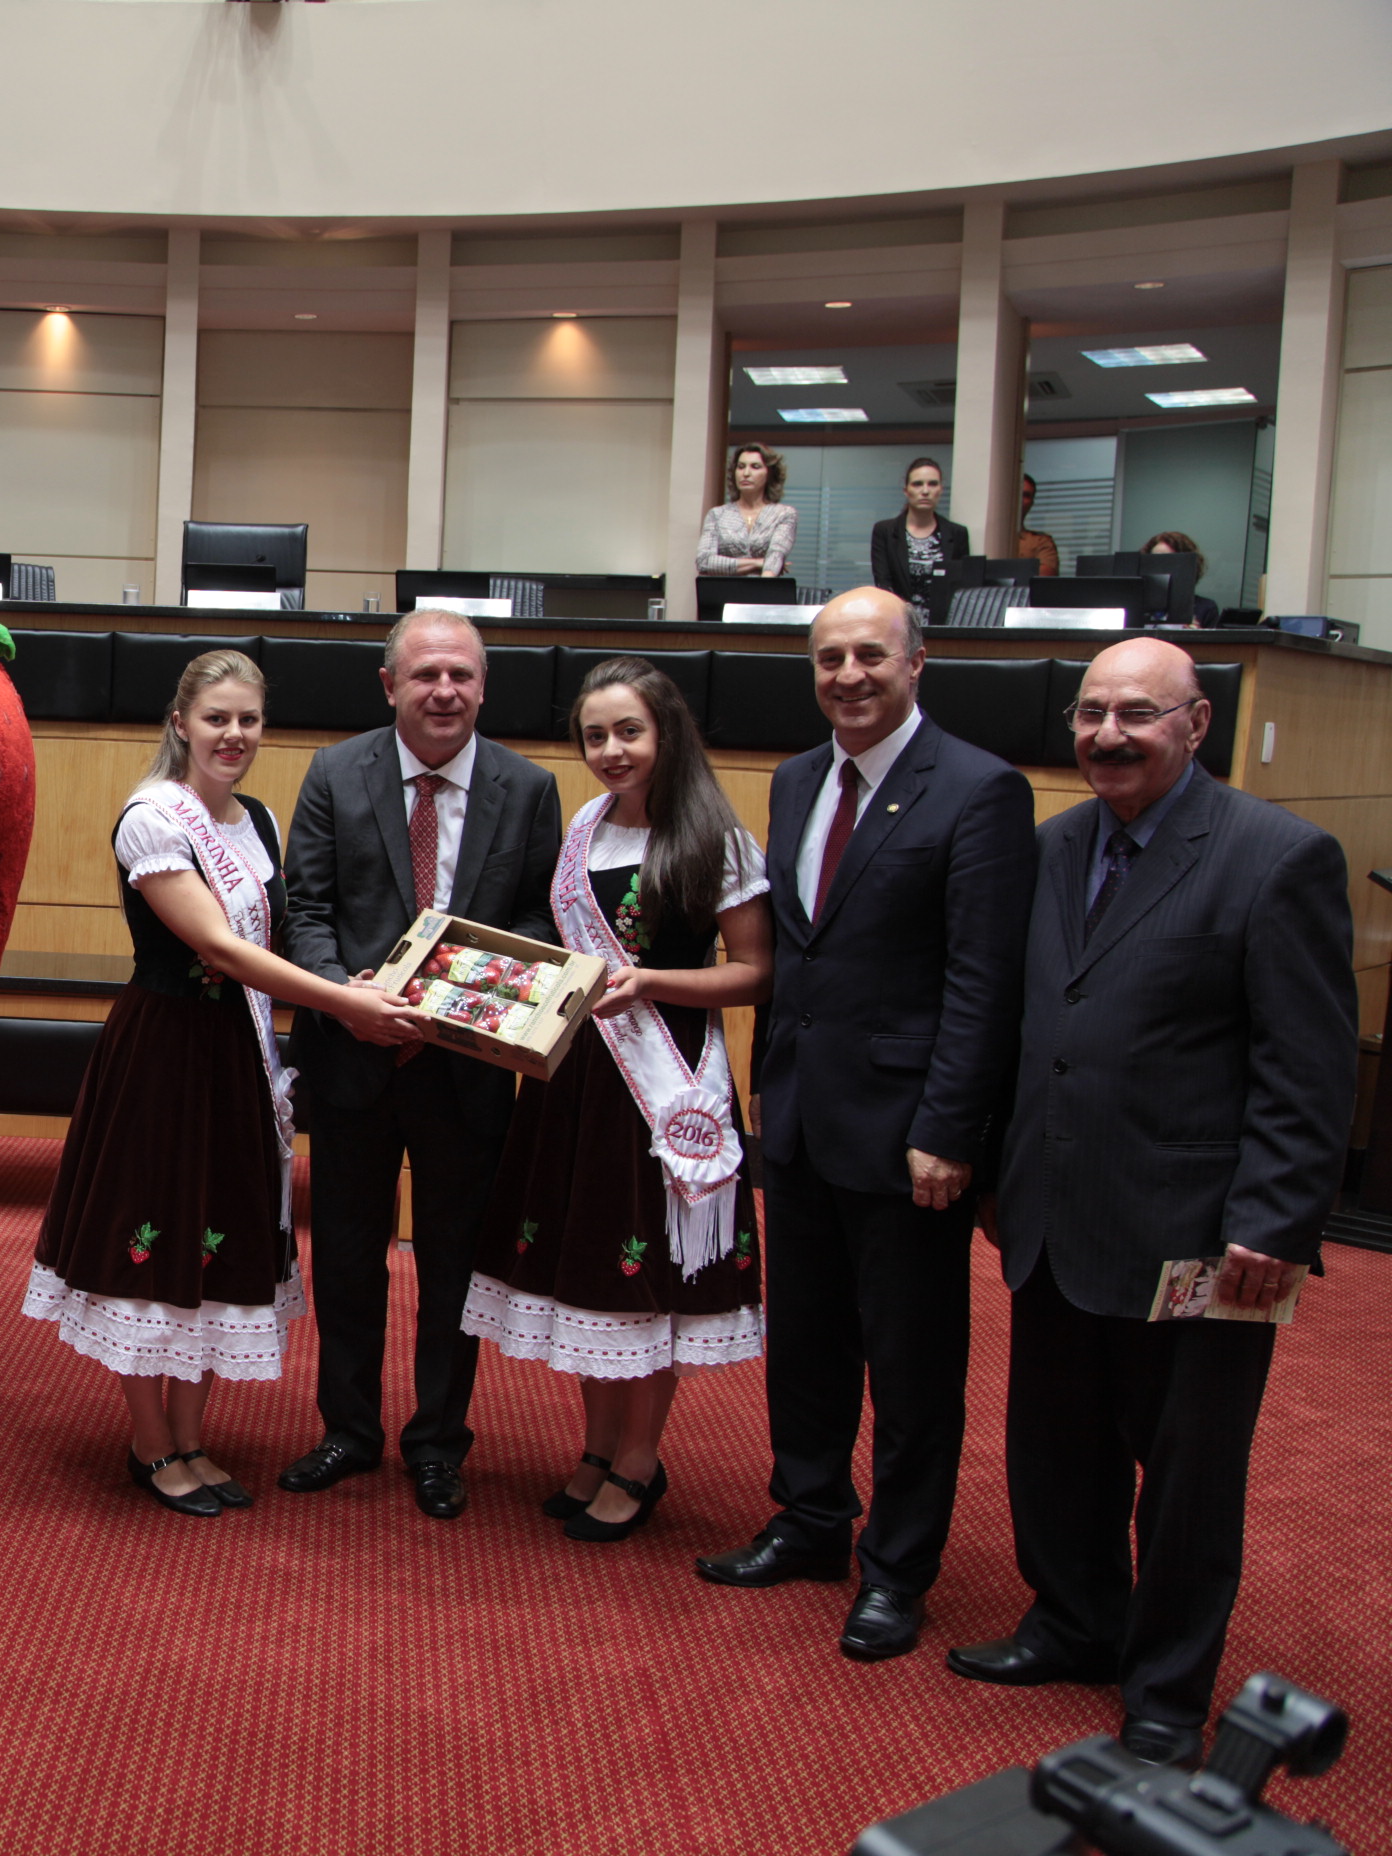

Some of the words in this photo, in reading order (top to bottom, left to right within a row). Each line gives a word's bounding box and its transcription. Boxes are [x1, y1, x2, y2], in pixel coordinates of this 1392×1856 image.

[169, 800, 245, 894] MADRINHA
[248, 903, 261, 931] XXV
[626, 1005, 642, 1037] orango
[668, 1121, 715, 1147] 2016
